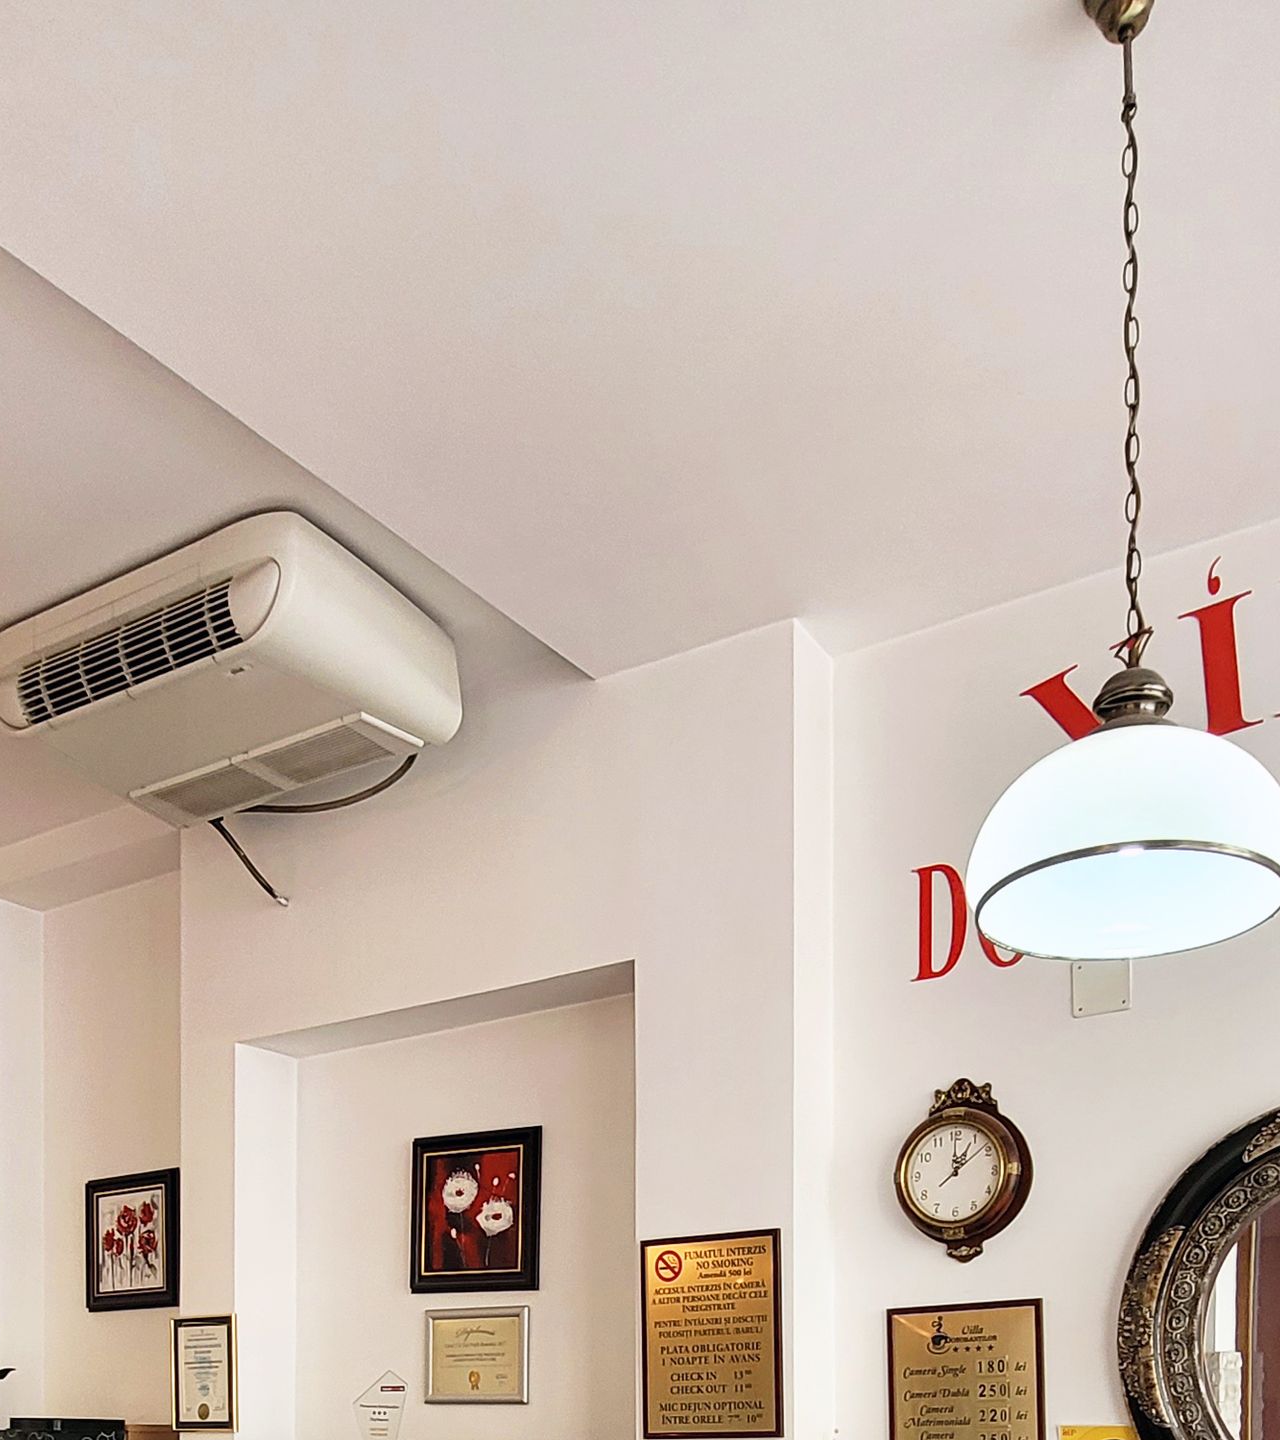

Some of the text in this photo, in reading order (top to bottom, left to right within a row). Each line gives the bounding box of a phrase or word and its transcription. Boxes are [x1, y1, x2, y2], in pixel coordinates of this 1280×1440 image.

[950, 1129, 962, 1142] 12
[972, 1133, 978, 1144] 1
[933, 1137, 943, 1148] 11
[984, 1145, 992, 1157] 2
[919, 1152, 932, 1163] 10
[990, 1164, 998, 1176] 3
[914, 1171, 921, 1183] 9
[920, 1189, 928, 1201] 8
[984, 1184, 992, 1196] 4
[933, 1202, 941, 1214] 7
[951, 1206, 959, 1217] 6
[969, 1200, 978, 1211] 5
[684, 1245, 767, 1260] FUMATUL INTERZIS
[696, 1257, 754, 1271] NO SMOKING
[654, 1285, 687, 1296] ACCESUL
[687, 1283, 722, 1293] INTERZIS
[682, 1292, 721, 1303] PERSOANE
[748, 1289, 769, 1299] CELE
[654, 1319, 682, 1329] PENTRU
[660, 1341, 762, 1355] PLATA OBLIGATORIE
[670, 1355, 710, 1366] NOAPTE
[728, 1353, 761, 1364] AVANS
[937, 1364, 967, 1378] Single
[977, 1359, 1006, 1374] 180
[1014, 1361, 1027, 1372] lei
[670, 1371, 705, 1382] CHECK
[705, 1371, 717, 1381] IN
[670, 1385, 705, 1395] CHECK
[705, 1384, 728, 1394] OUT
[978, 1383, 1007, 1398] 250
[1015, 1385, 1028, 1396] lei
[659, 1402, 679, 1412] MIC
[679, 1401, 712, 1413] DEJUN
[691, 1414, 724, 1425] ORELE
[979, 1408, 1008, 1422] 220
[1015, 1410, 1029, 1421] lei
